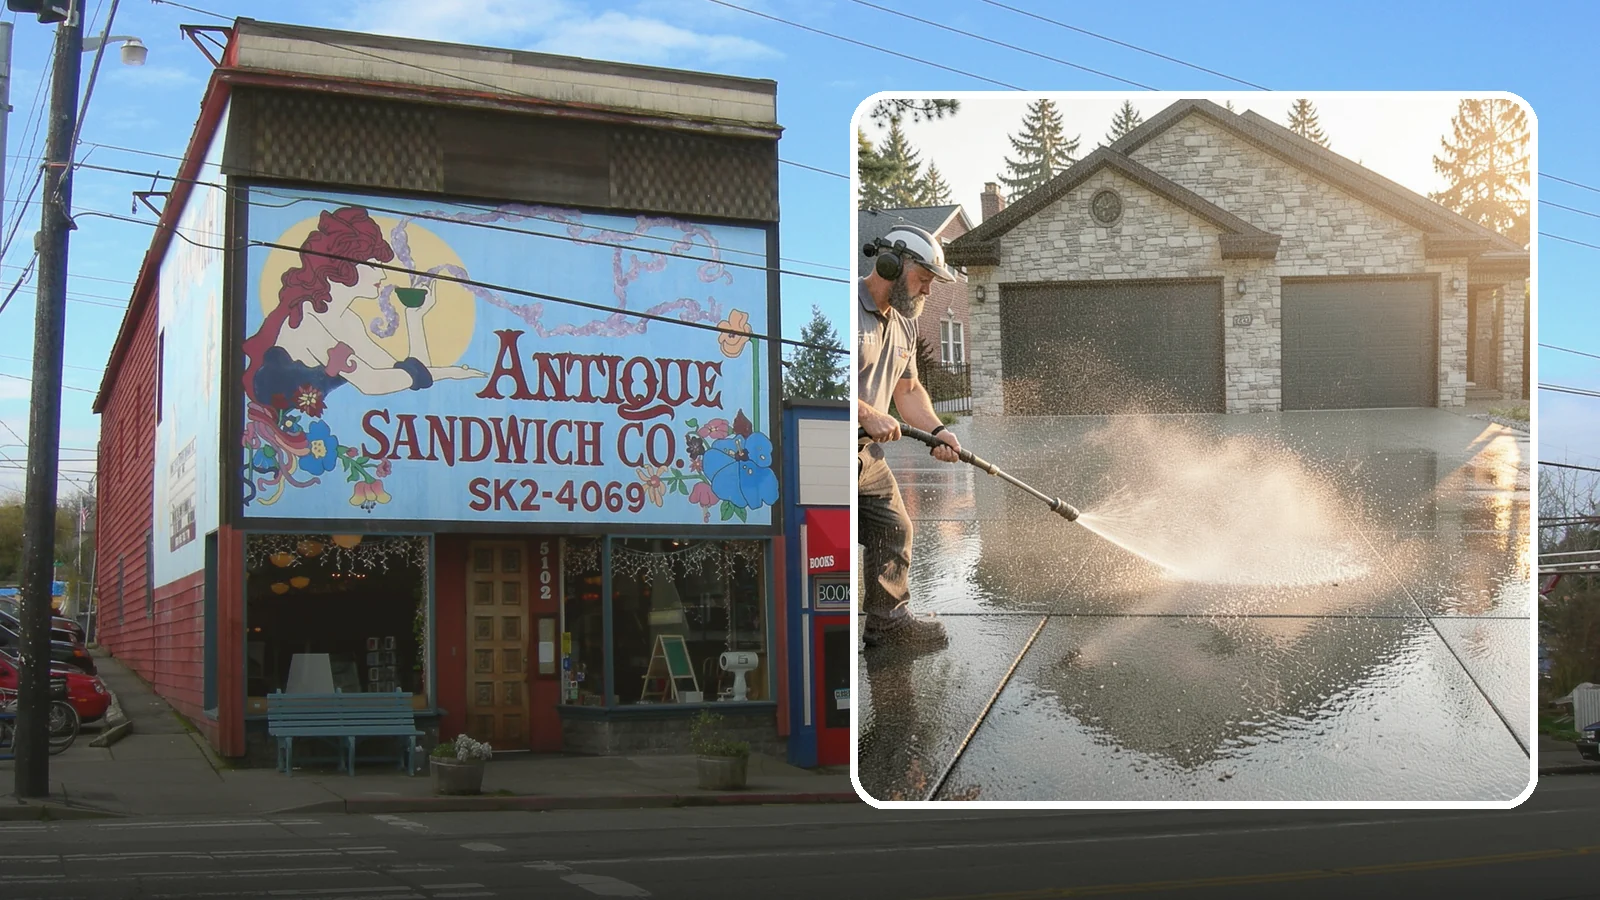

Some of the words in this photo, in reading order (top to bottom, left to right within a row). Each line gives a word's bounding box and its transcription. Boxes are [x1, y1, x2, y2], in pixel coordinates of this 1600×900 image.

[476, 329, 723, 420] ANTIQUE
[361, 408, 605, 467] SANDWICH
[617, 421, 685, 469] CO.
[468, 477, 646, 514] SK2-4069
[540, 541, 551, 599] 5102
[809, 555, 835, 569] BOOKS
